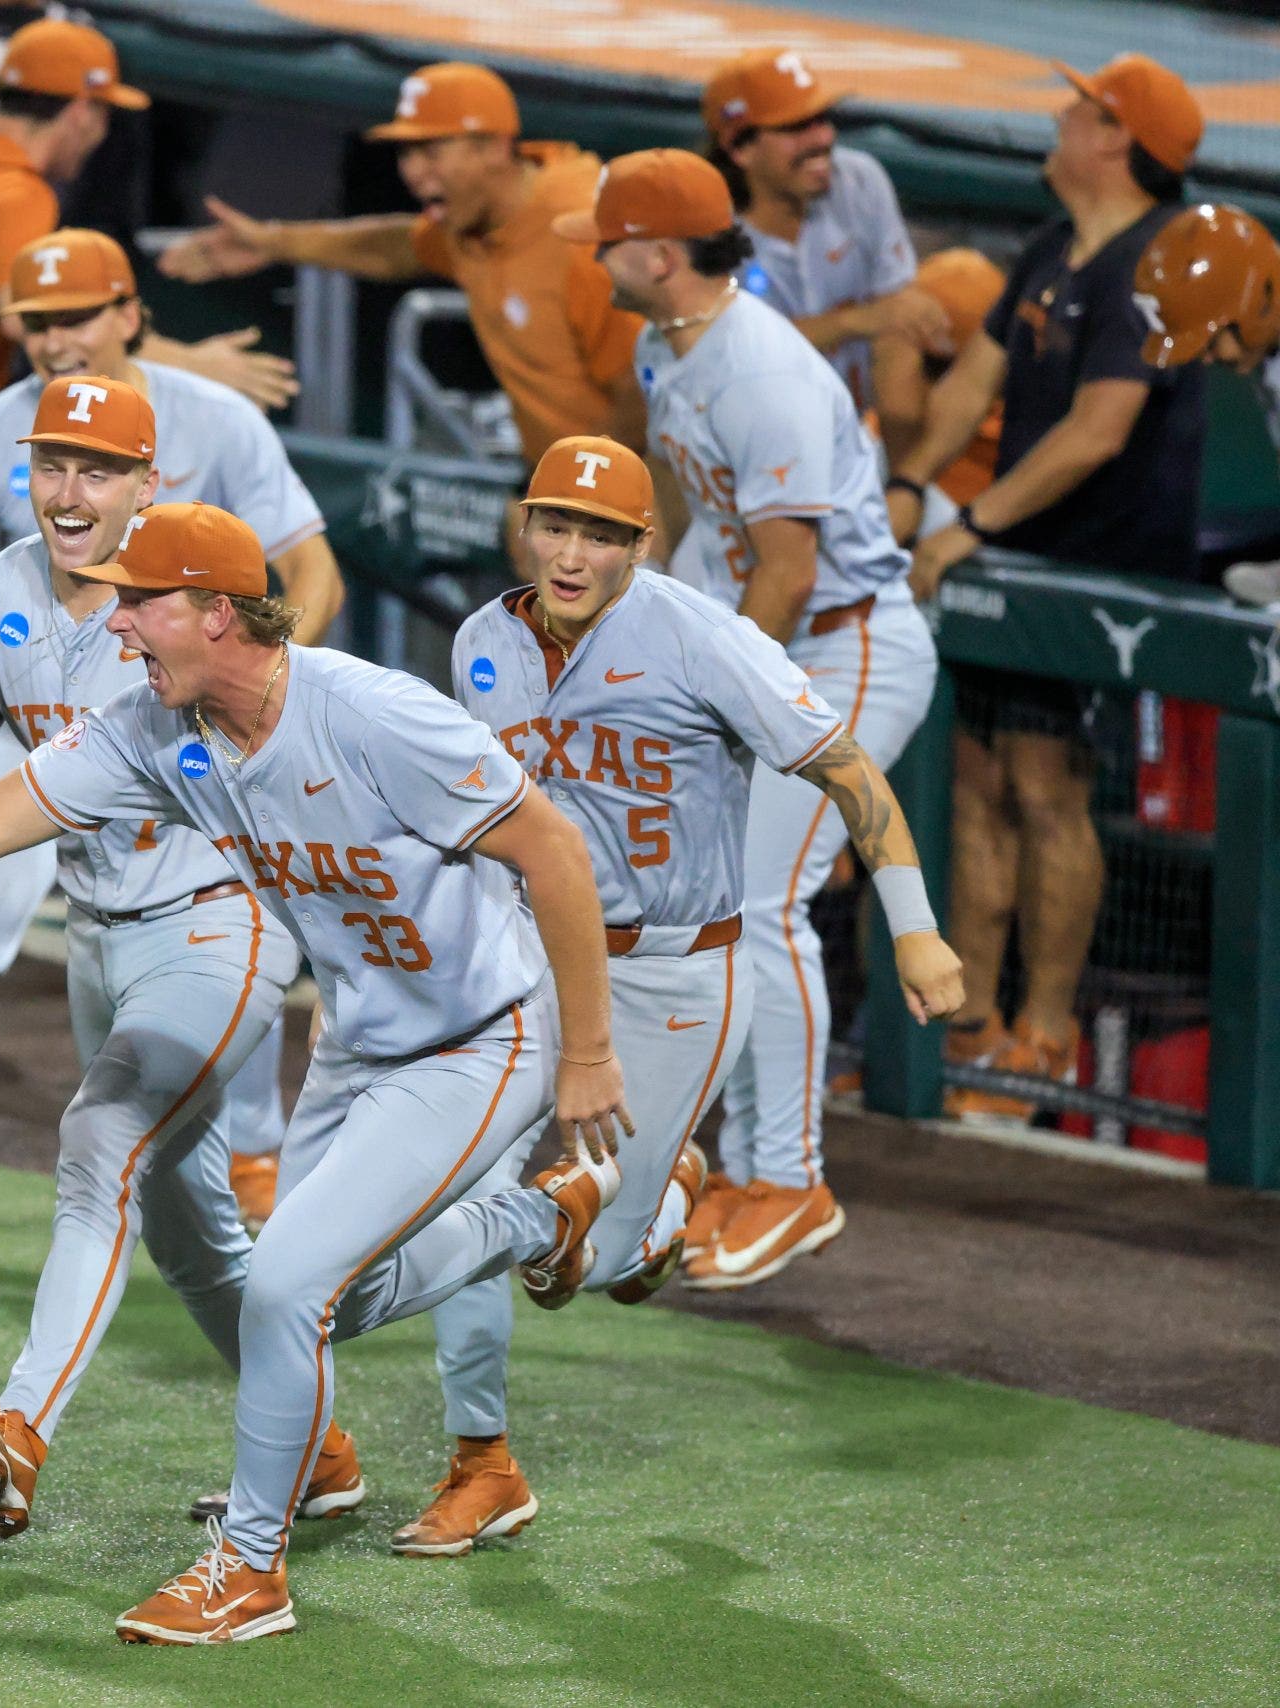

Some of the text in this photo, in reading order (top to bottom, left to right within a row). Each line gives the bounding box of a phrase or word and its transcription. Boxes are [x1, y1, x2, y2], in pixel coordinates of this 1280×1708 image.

[33, 246, 69, 285] T
[67, 383, 108, 424] T
[575, 451, 611, 489] T
[118, 515, 147, 552] T
[0, 623, 27, 644] NCAA
[182, 758, 209, 772] NCAA
[498, 716, 673, 794] EXAS
[627, 804, 671, 870] 5
[341, 912, 433, 973] 33
